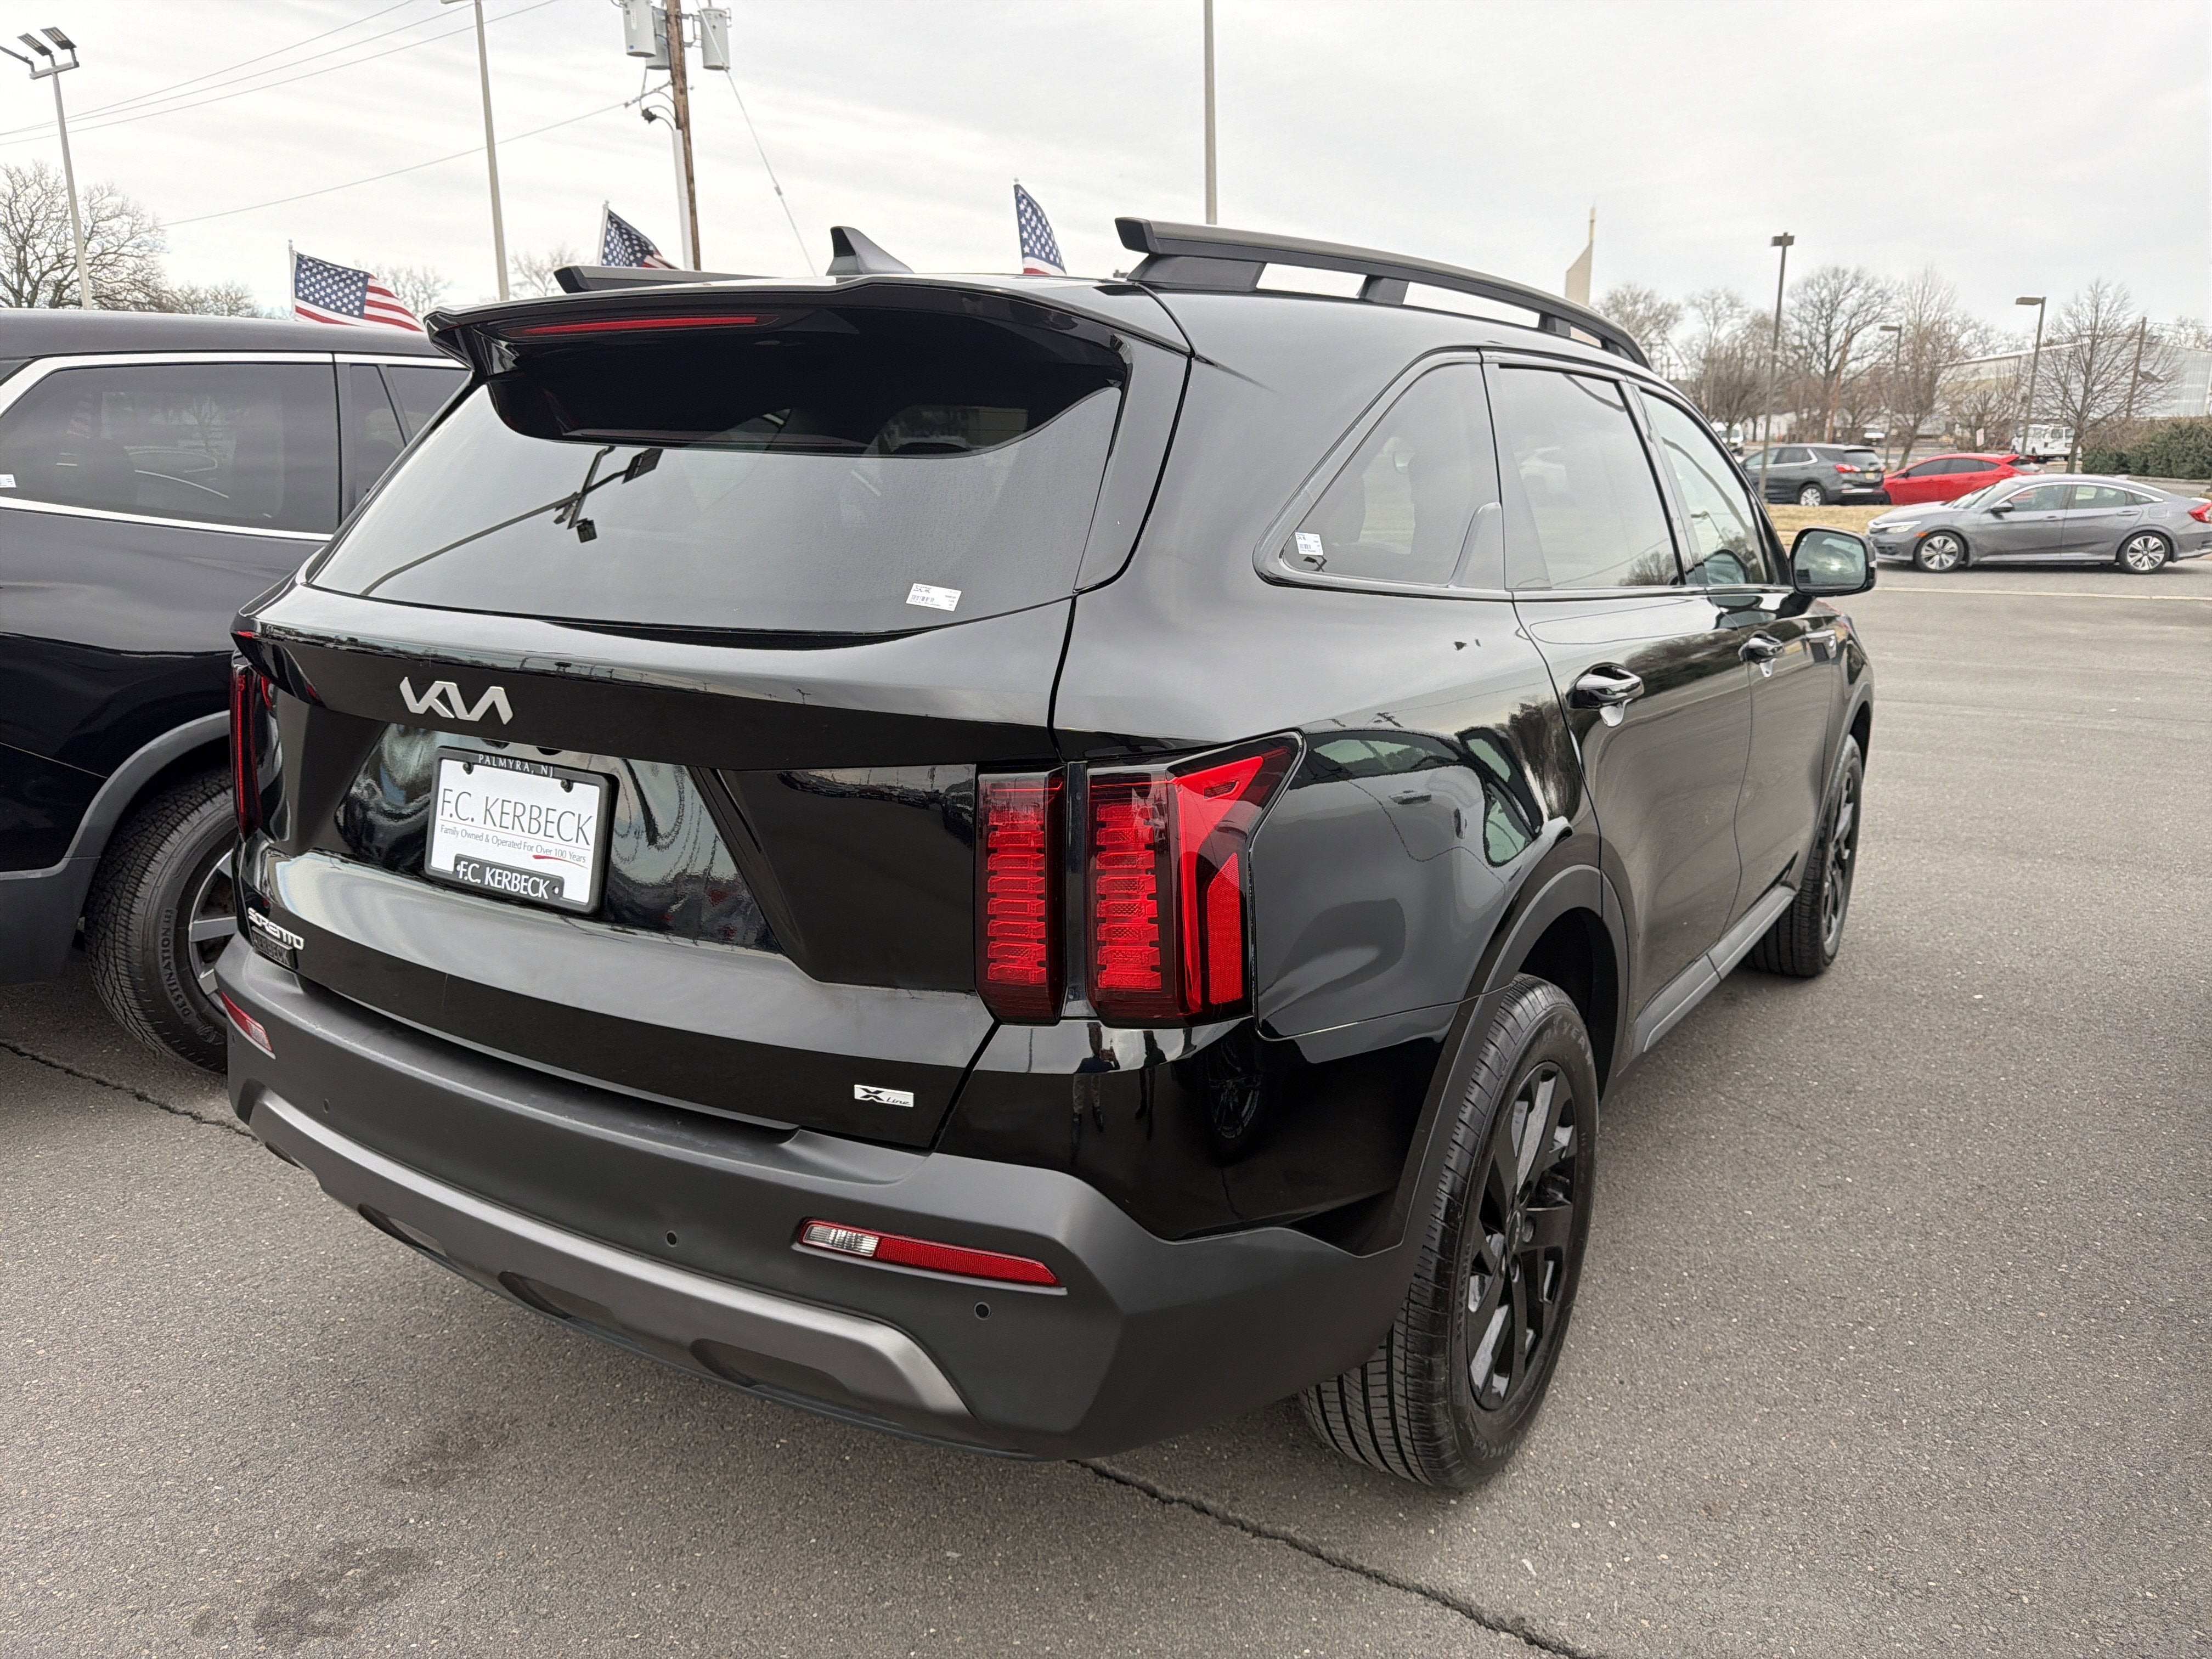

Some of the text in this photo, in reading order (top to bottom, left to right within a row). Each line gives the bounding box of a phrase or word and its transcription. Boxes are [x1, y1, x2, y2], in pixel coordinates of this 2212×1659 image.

[399, 676, 514, 725] KIA
[478, 754, 553, 777] PALMYRA, NJ
[441, 788, 593, 845] F.C. KERBECK
[440, 824, 460, 838] Family
[460, 828, 483, 842] Owned
[492, 836, 522, 849] Operated
[523, 843, 534, 853] For
[535, 844, 552, 855] Over
[555, 848, 567, 859] 100
[569, 851, 586, 864] Years
[484, 866, 550, 899] KERBECK
[161, 927, 191, 1017] DESTINATION
[860, 1087, 885, 1102] X
